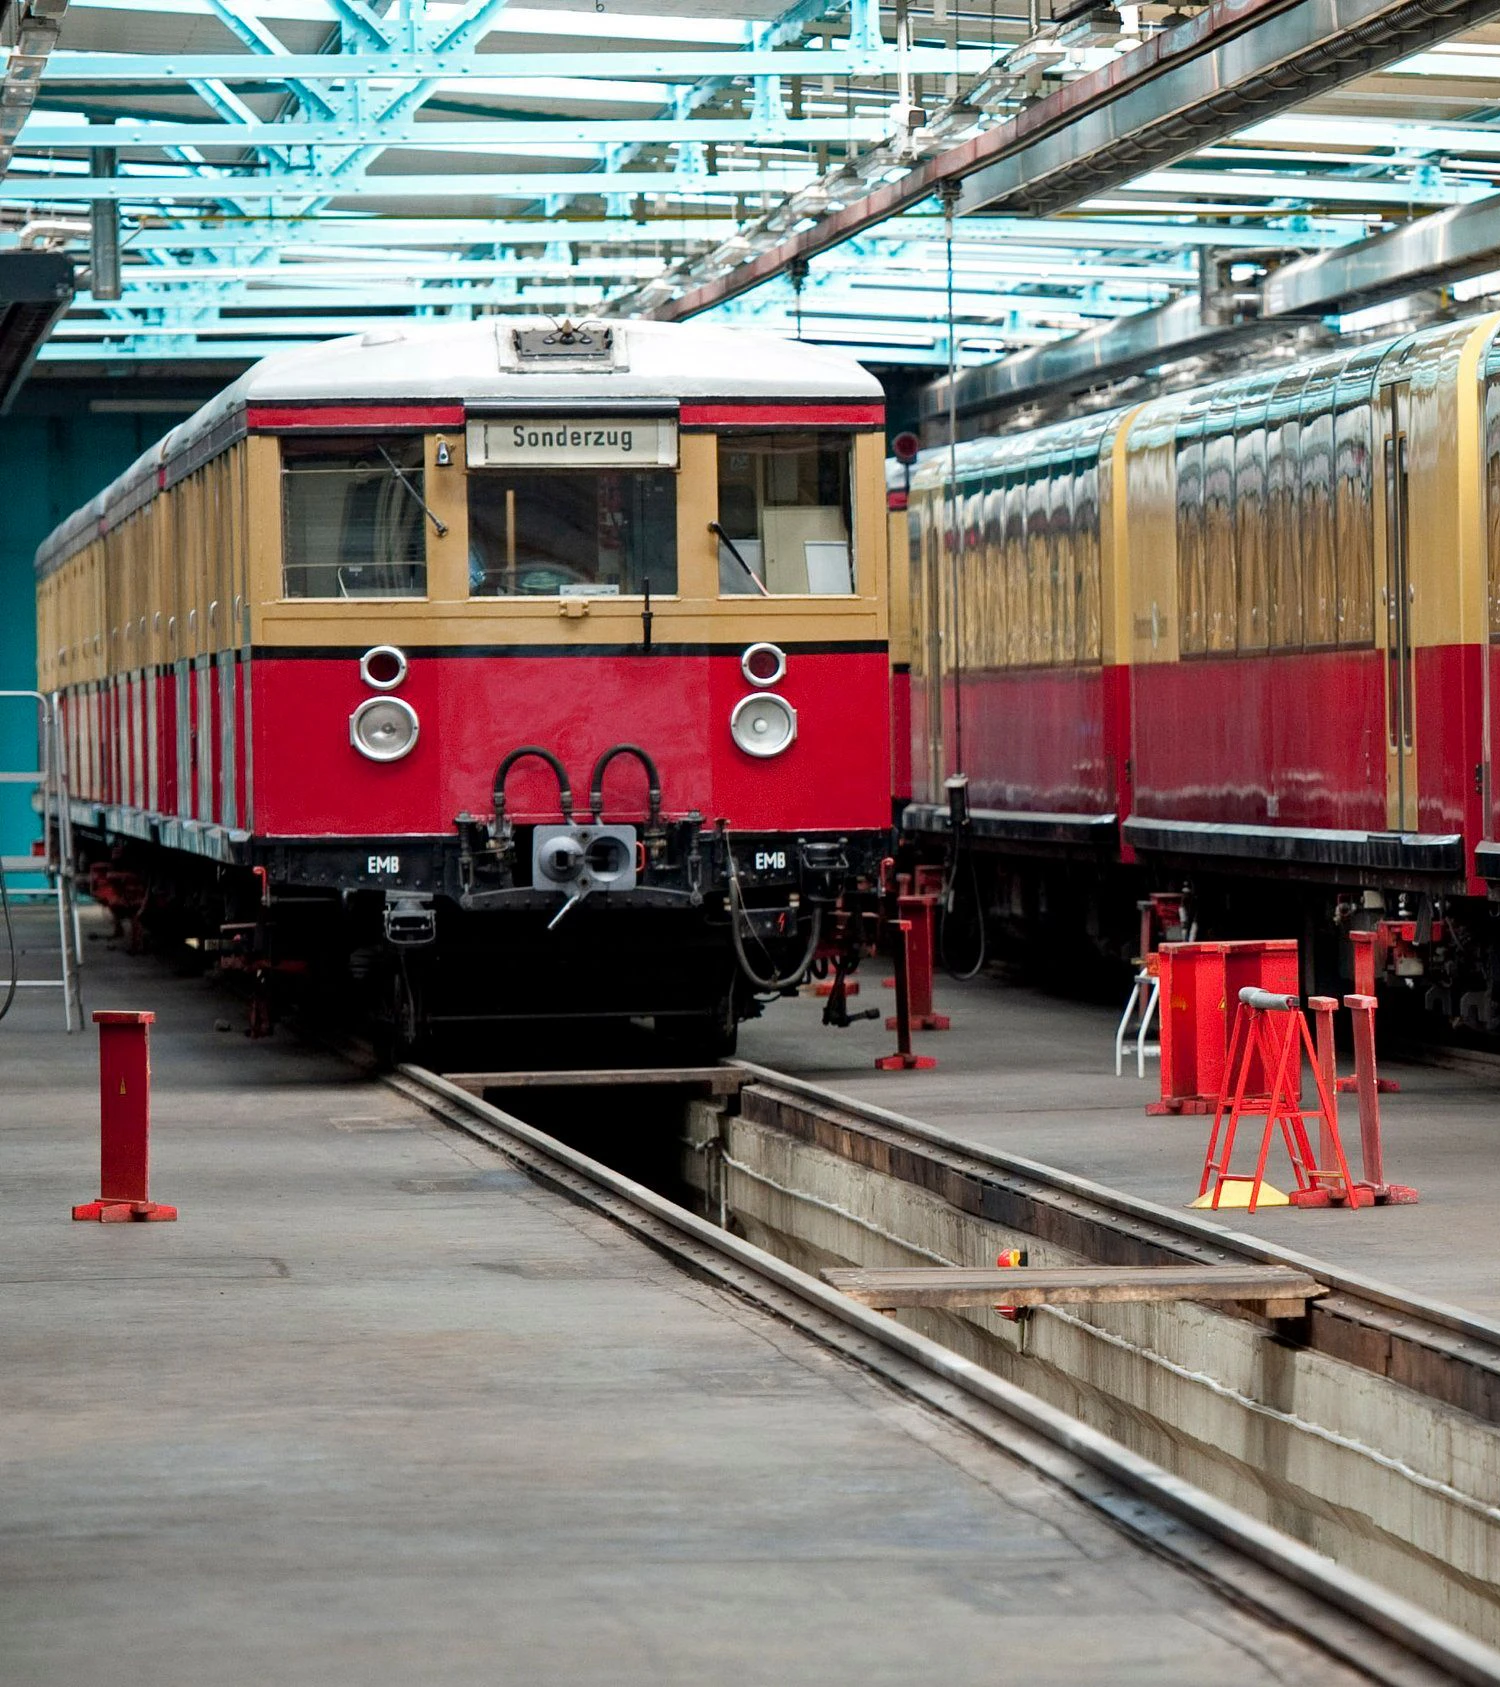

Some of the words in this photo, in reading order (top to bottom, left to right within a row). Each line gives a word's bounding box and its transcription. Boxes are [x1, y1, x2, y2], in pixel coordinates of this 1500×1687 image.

[513, 424, 633, 452] Sonderzug
[367, 855, 400, 874] EMB
[755, 851, 786, 870] EMB
